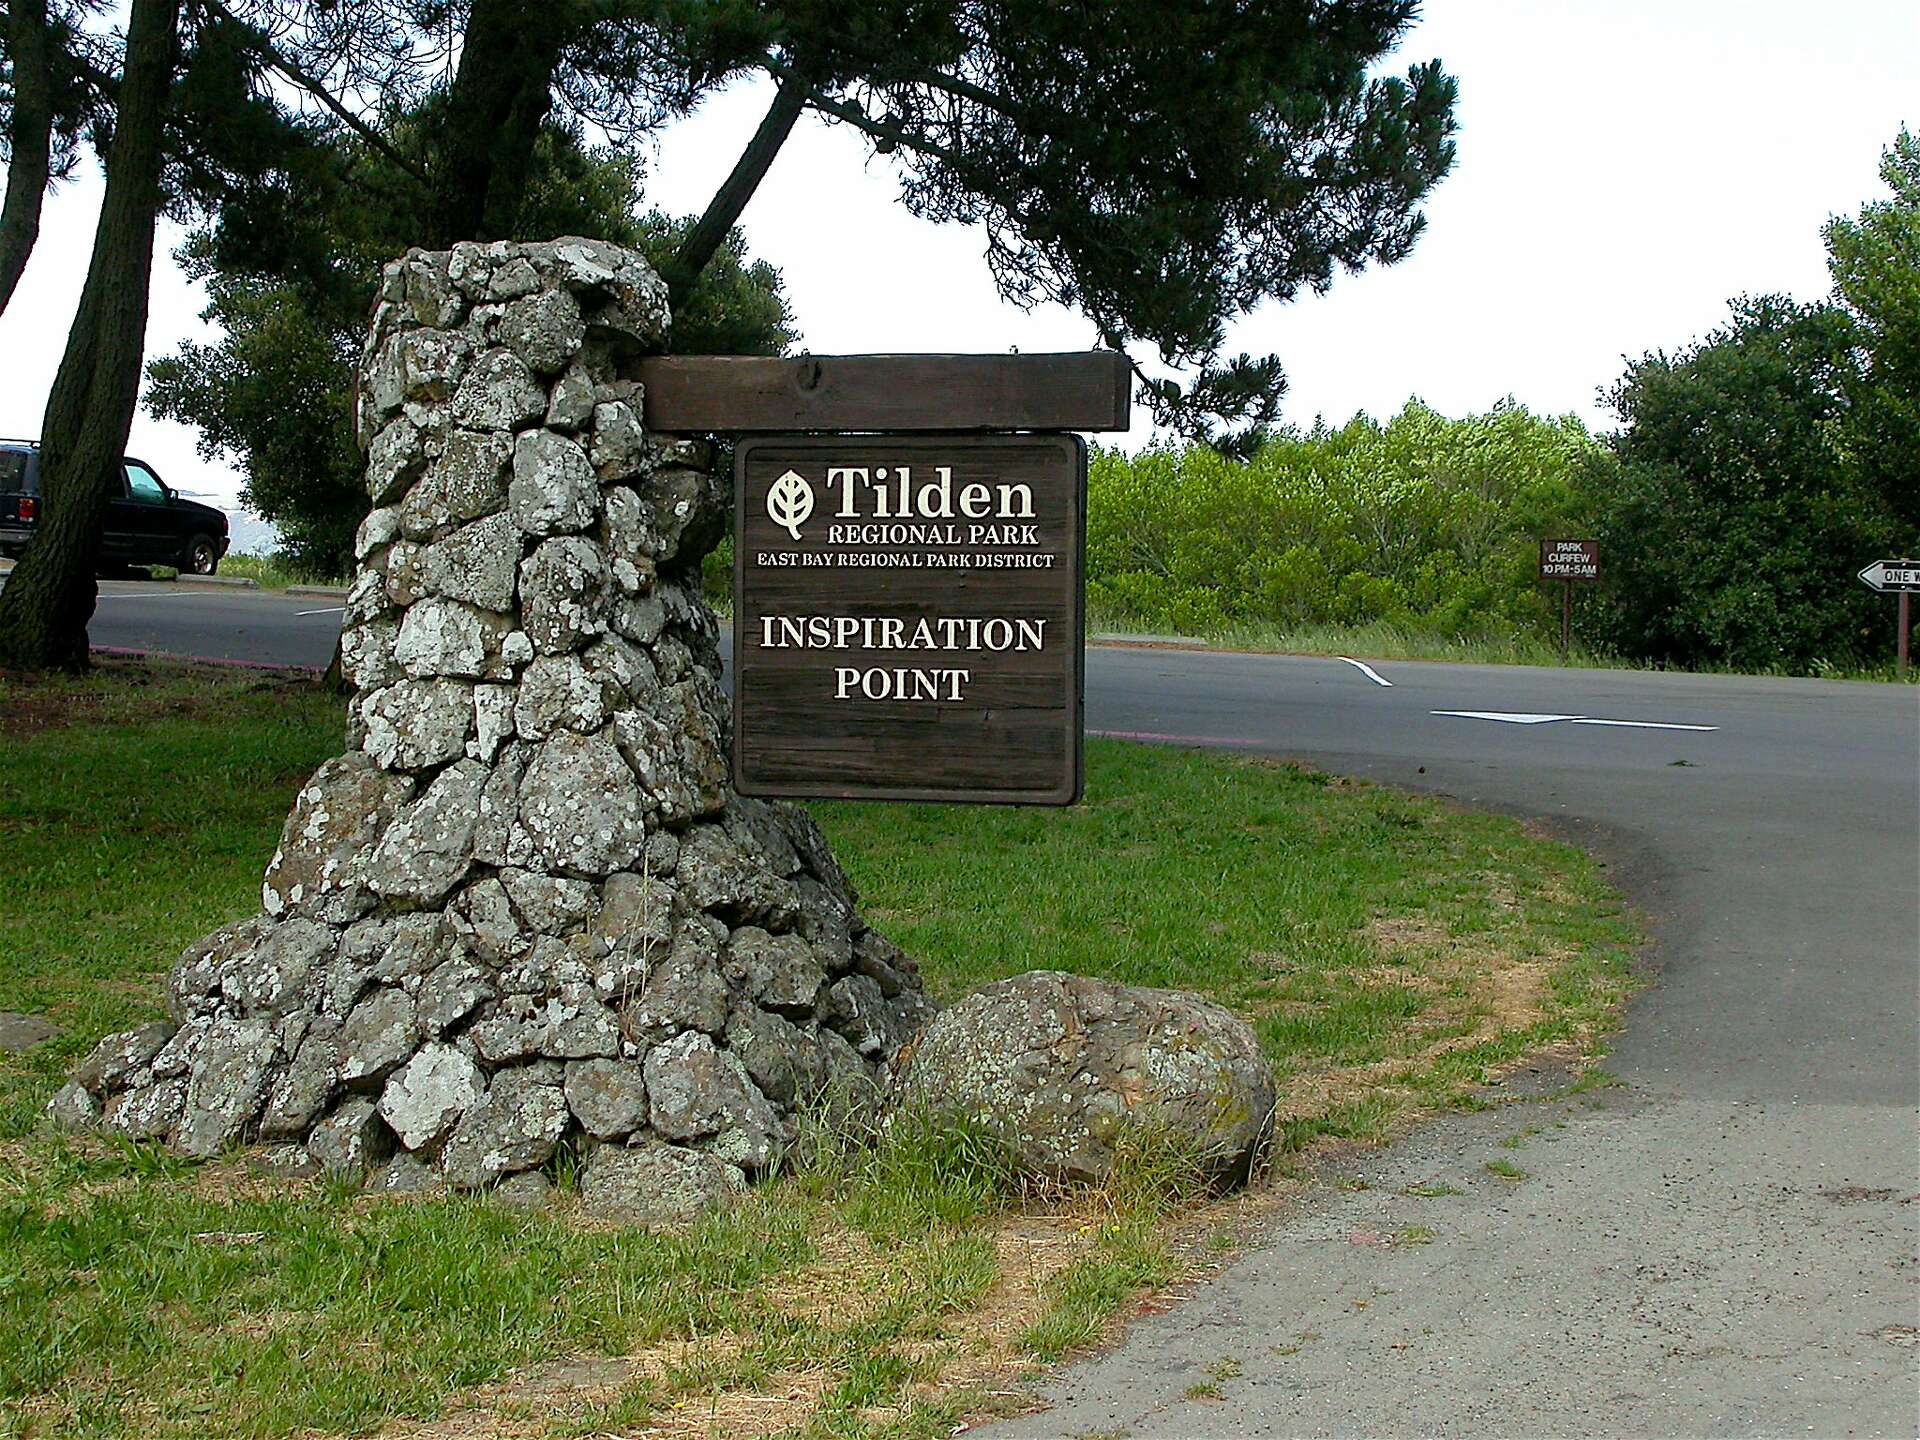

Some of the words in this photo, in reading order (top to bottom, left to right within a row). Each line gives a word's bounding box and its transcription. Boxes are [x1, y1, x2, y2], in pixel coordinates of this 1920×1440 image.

[826, 466, 1037, 518] Tilden
[826, 524, 962, 545] REGIONAL
[968, 524, 1040, 546] PARK
[1556, 542, 1583, 552] PARK
[757, 552, 799, 567] EAST
[802, 552, 834, 567] BAY
[837, 552, 923, 568] REGIONAL
[926, 553, 971, 568] PARK
[974, 553, 1055, 569] DISTRICT
[1548, 553, 1590, 563] CURFEW
[1542, 564, 1554, 574] 10
[1581, 564, 1597, 574] AM
[1885, 570, 1910, 582] ONE
[760, 616, 1046, 650] INSPIRATION
[833, 667, 970, 701] POINT
